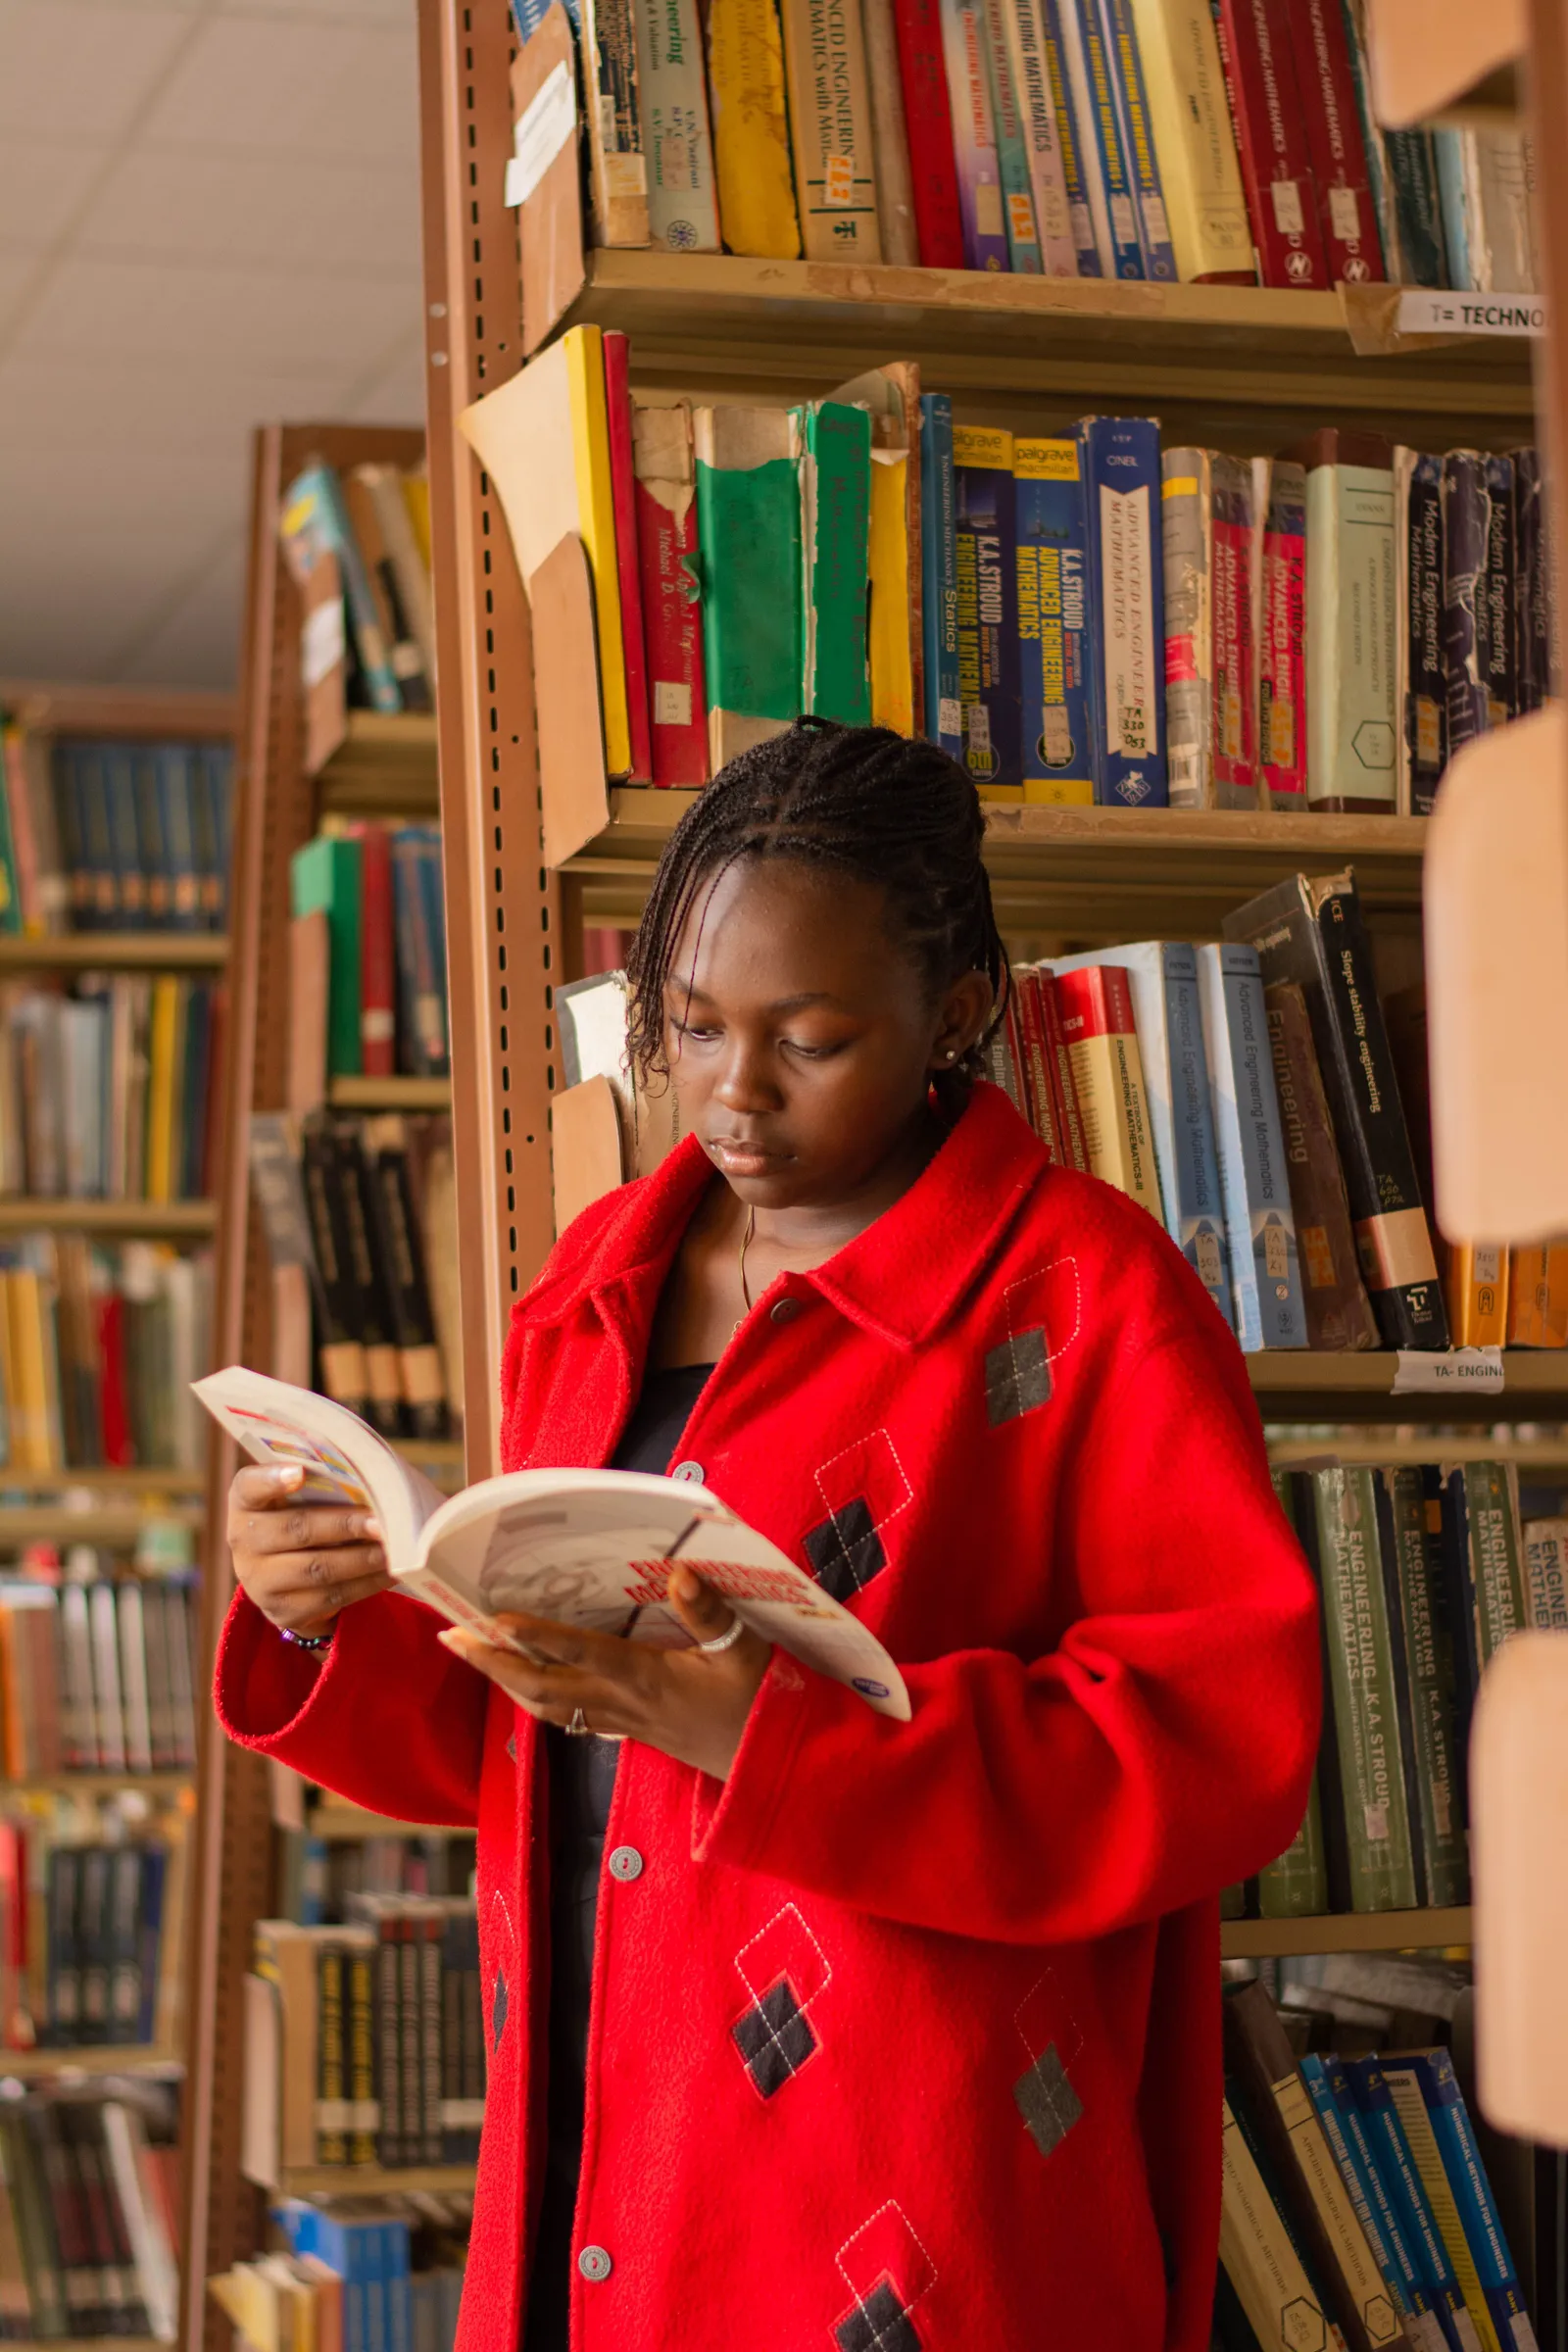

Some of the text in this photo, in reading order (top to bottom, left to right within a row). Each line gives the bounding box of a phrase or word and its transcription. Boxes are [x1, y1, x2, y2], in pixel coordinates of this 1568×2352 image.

[648, 20, 662, 71] Valuation
[962, 12, 989, 148] ENGINEERING MATHEMATICS
[809, 76, 831, 111] with
[827, 52, 858, 171] ENGINEERIN
[1024, 56, 1053, 153] MATHEMATICS
[1261, 69, 1286, 153] MATHEMATICS
[1321, 75, 1345, 159] MATHEMATICS
[1016, 447, 1075, 463] palgrave
[656, 527, 672, 575] Michael
[943, 524, 954, 585] MECHANICS
[956, 533, 978, 626] ENGINEERING
[1015, 546, 1040, 640] MATHEMATICS
[1109, 500, 1126, 640] MATHEMATICS
[1125, 500, 1142, 603] ADVANCED
[1223, 546, 1237, 640] ADVANCED
[1410, 525, 1424, 639] Mathematics
[1421, 499, 1441, 673] Modern Engineering
[1488, 502, 1509, 675] Modern Engineering
[944, 589, 957, 653] Statics
[1038, 546, 1065, 704] ADVANCED ENGINEERING
[1214, 540, 1226, 664] MATHEMATICS
[1273, 555, 1290, 650] ADVANCED
[1291, 592, 1303, 656] STROUD
[1122, 719, 1145, 731] 330
[1124, 707, 1142, 719] TA
[1330, 899, 1345, 923] ICE
[1177, 986, 1196, 1048] Advanced
[1238, 981, 1257, 1042] Advanced
[1340, 950, 1383, 1114] Slope stability engineering
[992, 1043, 1006, 1094] Engine
[1031, 1043, 1048, 1110] ENGINEERING
[1055, 1044, 1074, 1111] ENGINEERING
[1116, 1039, 1133, 1108] ENGINEERING
[1179, 1051, 1204, 1125] Engineering
[1244, 1045, 1267, 1118] Engineering
[1266, 1009, 1311, 1163] Engineering
[1124, 1108, 1145, 1192] MATHEMATICS-III
[1132, 1089, 1144, 1133] TEXTBOOK
[1138, 1134, 1146, 1147] OF
[1190, 1127, 1211, 1208] Mathematics
[1254, 1121, 1276, 1200] Mathematics
[1376, 1175, 1393, 1185] TA
[627, 1557, 808, 1591] ENNEERING
[1333, 1531, 1360, 1681] MATHEMATICS
[1402, 1529, 1425, 1678] MATHEMATICS
[1411, 1529, 1437, 1677] ENGINEERING
[1476, 1509, 1501, 1655] MATHEMATICS
[1348, 1530, 1377, 1680] ENGINEERING
[1370, 1733, 1392, 1809] STROUD
[1301, 2135, 1368, 2287] APPLIED NUMERICAL METHODS
[1320, 2109, 1390, 2268] NUMERICAL METHODS FOR ENGINEERS
[1348, 2113, 1370, 2167] NUMERICAL
[1365, 2166, 1388, 2211] METHODS
[1381, 2210, 1395, 2230] FOR
[1390, 2230, 1415, 2281] ENGINEERS
[1381, 2112, 1404, 2165] NUMERICAL
[1398, 2164, 1419, 2209] METHODS
[1412, 2208, 1425, 2229] FOR
[1421, 2228, 1447, 2281] ENGINEERS
[1449, 2107, 1474, 2160] NUMERICAL
[1465, 2160, 1487, 2206] METHODS
[1481, 2206, 1493, 2227] FOR
[1487, 2226, 1510, 2279] ENGINEERS
[1260, 2243, 1289, 2296] METHODS
